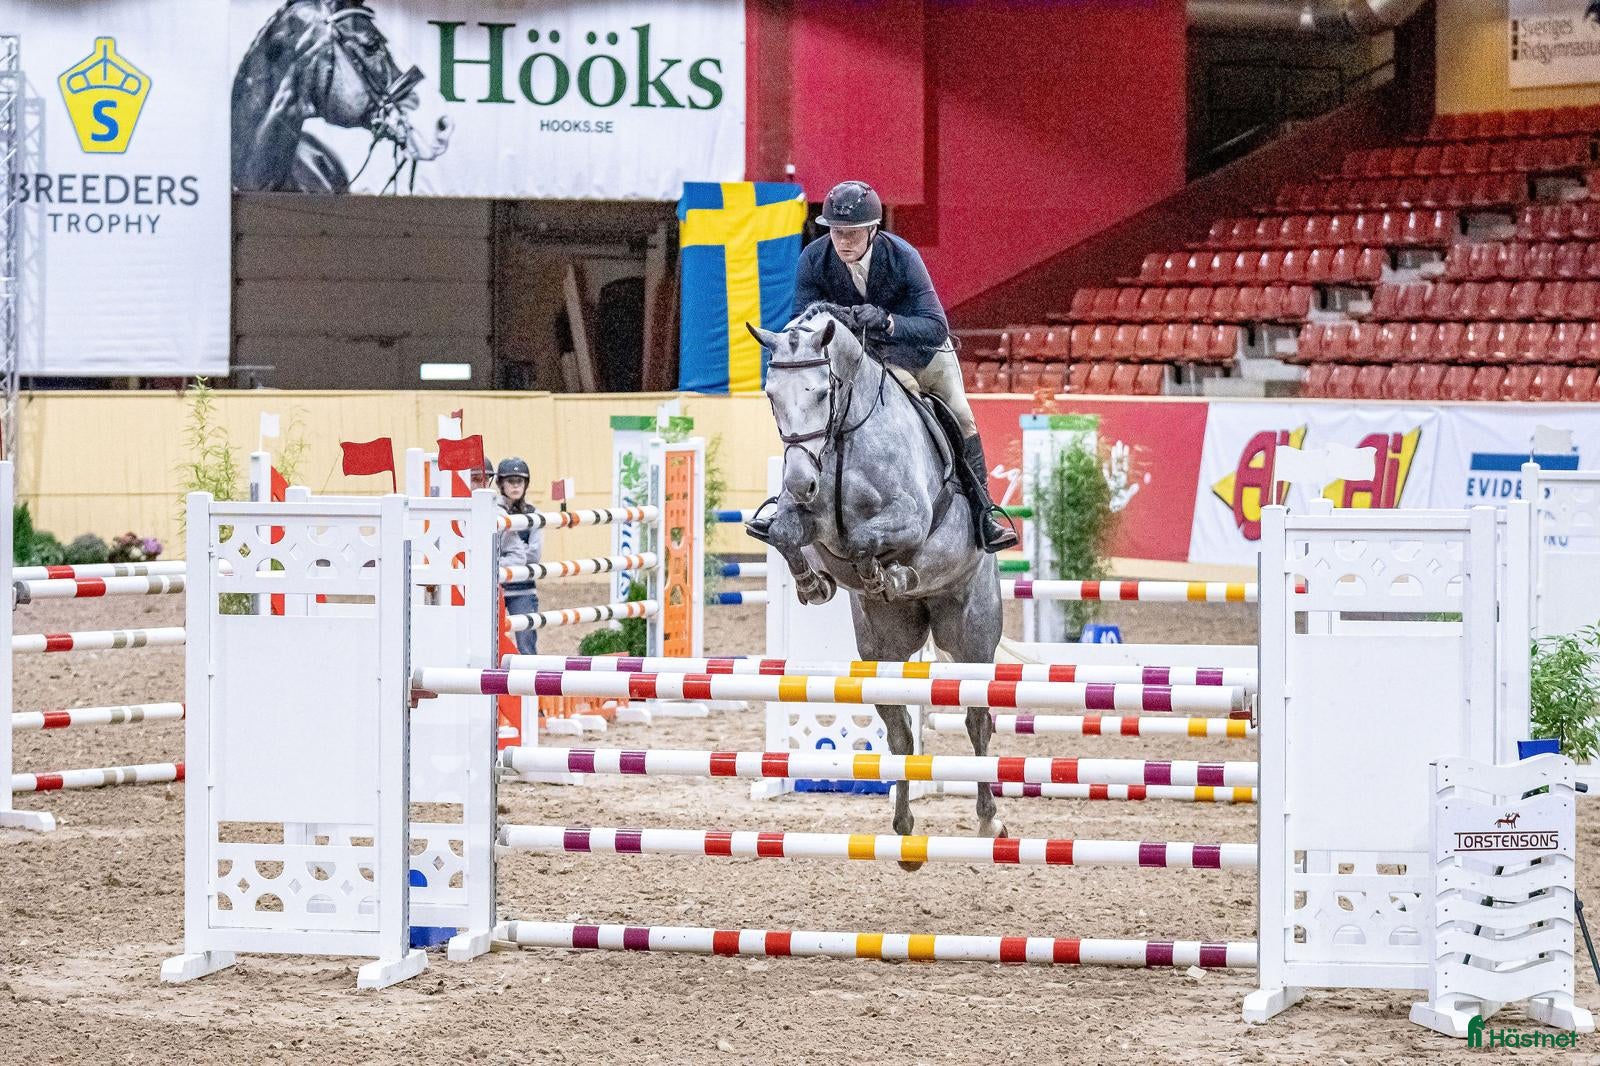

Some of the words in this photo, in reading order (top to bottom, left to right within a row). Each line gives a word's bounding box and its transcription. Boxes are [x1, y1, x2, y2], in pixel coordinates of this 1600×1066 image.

[428, 20, 723, 110] Hööks
[91, 100, 119, 142] S
[540, 119, 613, 134] HOOKS.SE
[9, 173, 199, 206] BREEDERS
[48, 213, 161, 234] TROPHY
[1457, 832, 1559, 850] TORSTENSONS
